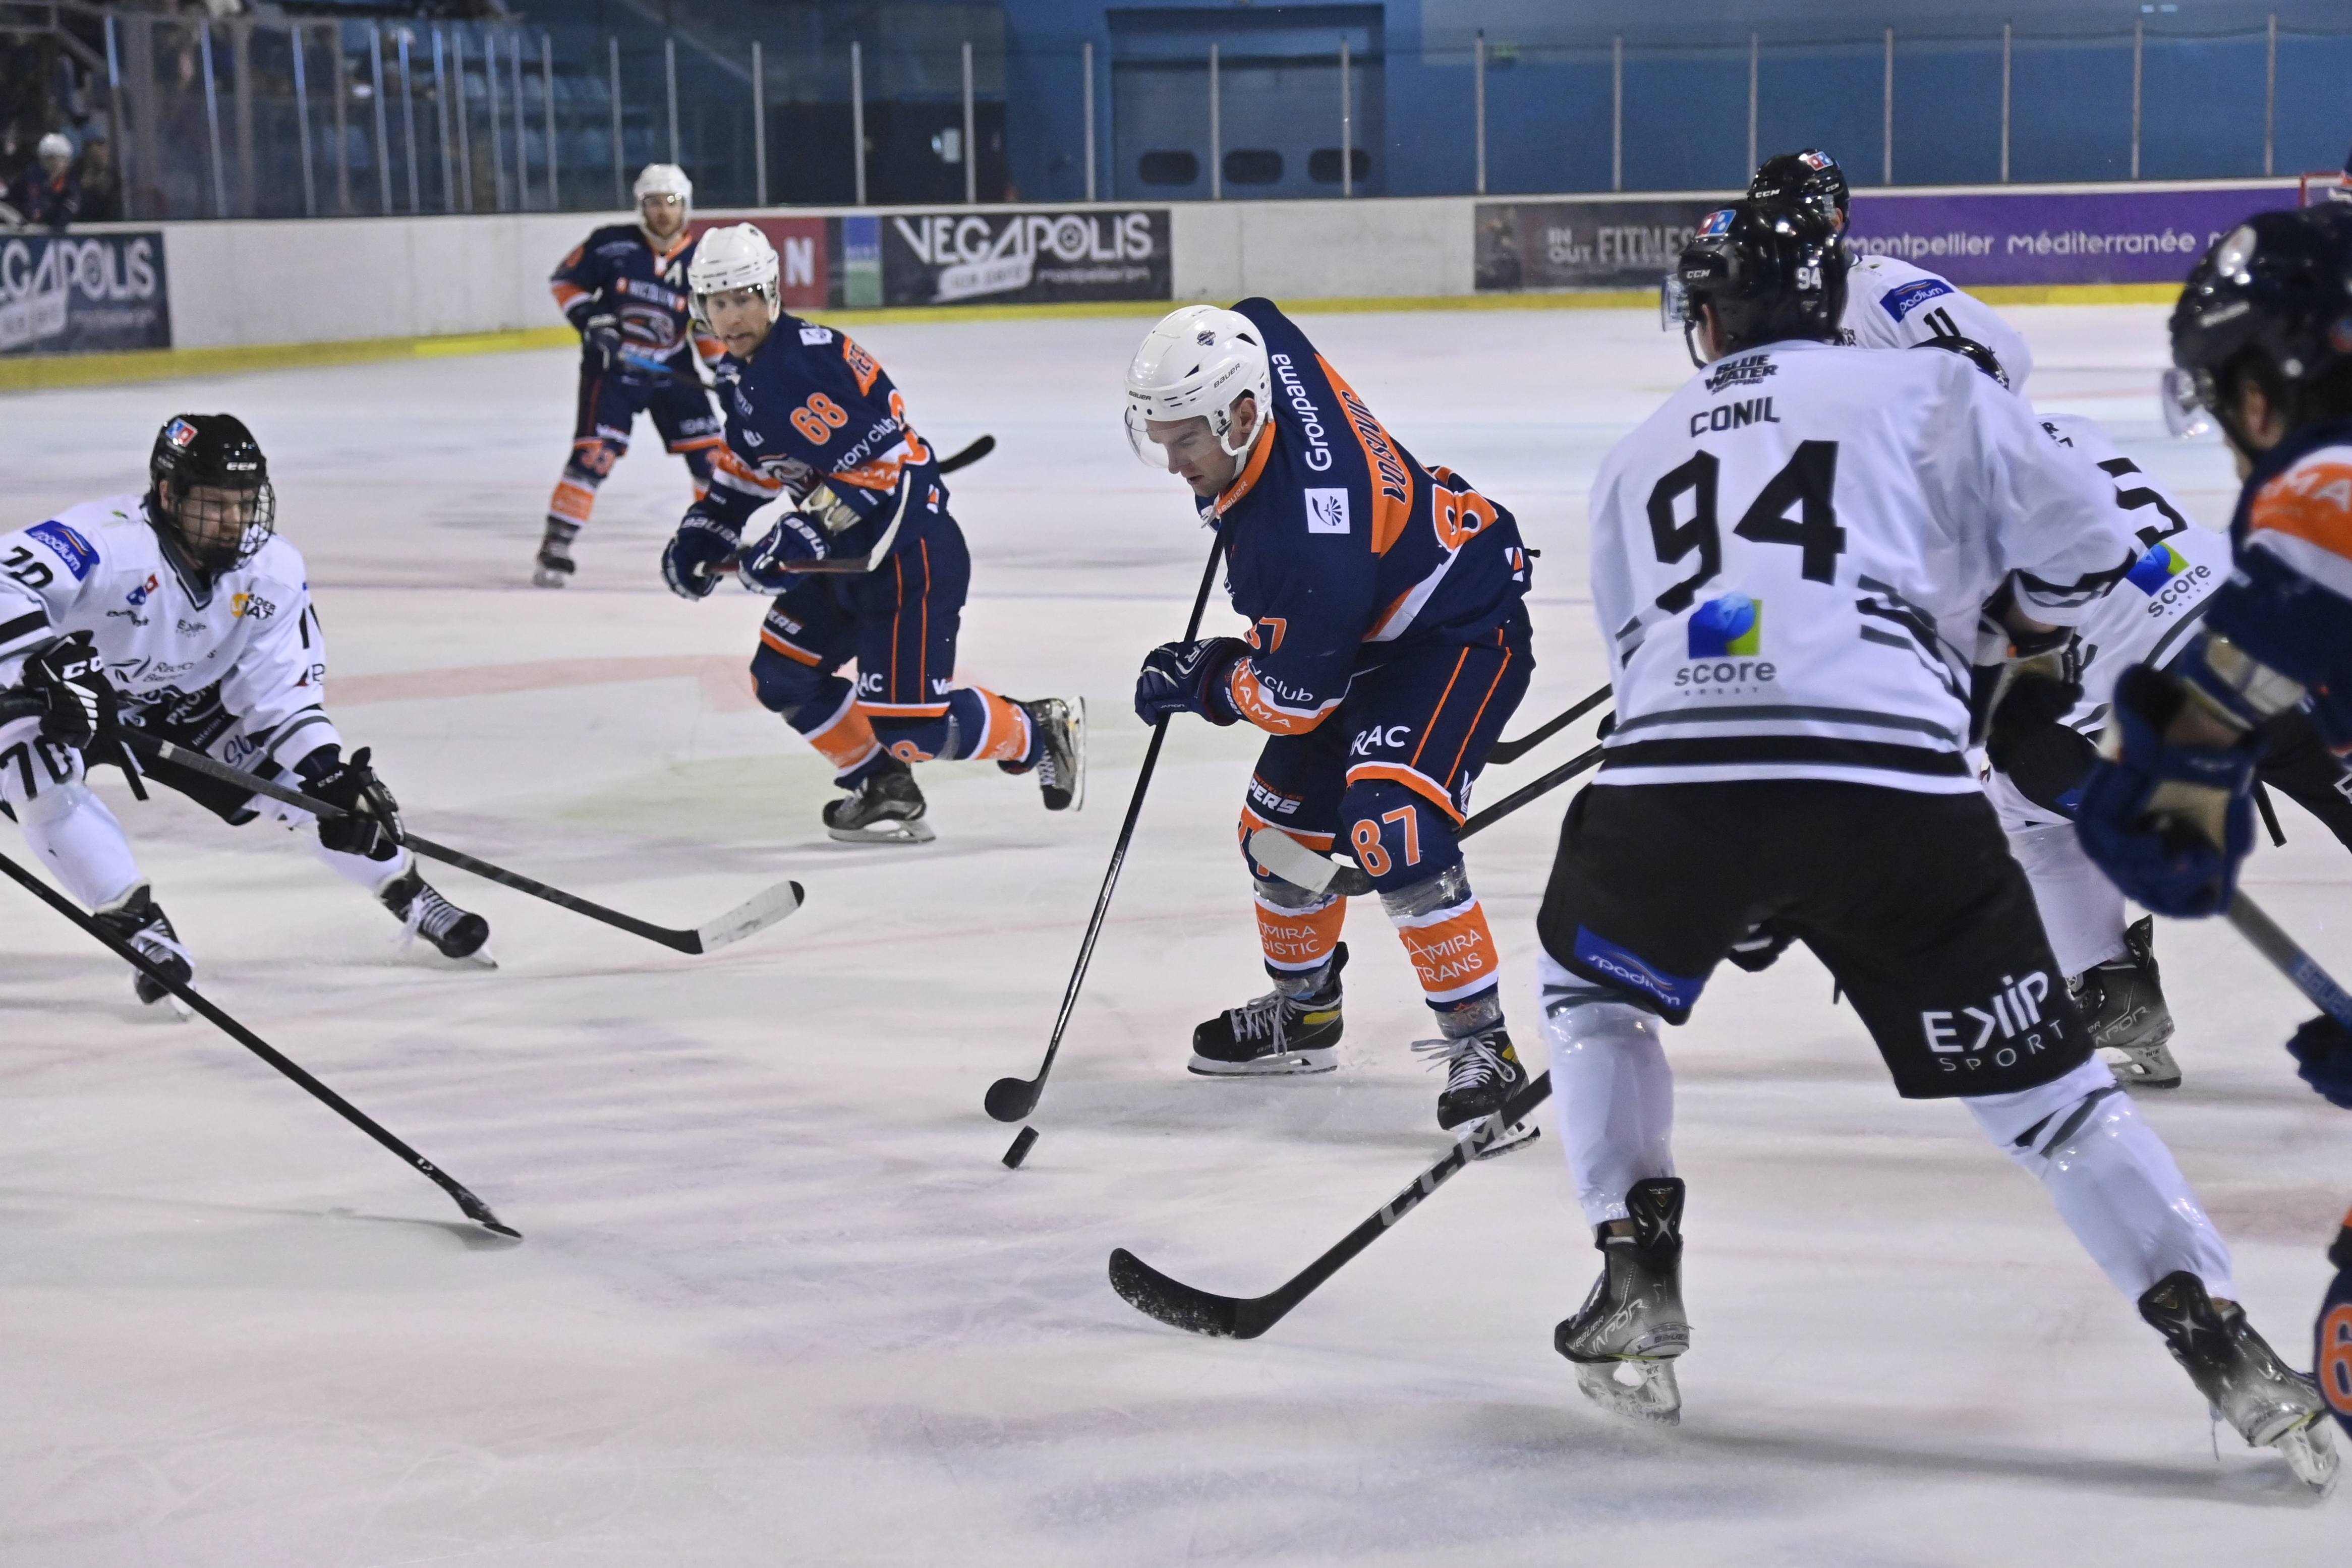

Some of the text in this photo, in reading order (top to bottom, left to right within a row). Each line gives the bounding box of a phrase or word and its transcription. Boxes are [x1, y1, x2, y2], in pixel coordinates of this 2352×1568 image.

[1755, 189, 1781, 199] CCM
[894, 213, 1154, 264] VEGAPOLIS
[1843, 231, 1994, 259] montpellier
[0, 238, 156, 302] GAPOLIS
[1686, 269, 1711, 279] CCM
[1795, 267, 1822, 290] 94
[1214, 363, 1241, 388] BAUER
[1705, 364, 1779, 390] WATER
[1128, 390, 1152, 401] BAUER
[789, 392, 849, 446] 68
[1271, 354, 1333, 472] Groupama
[1691, 396, 1781, 438] CONIL
[226, 461, 258, 471] CCM
[1221, 481, 1248, 512] BAUER
[1646, 439, 1847, 615] 94
[2148, 564, 2211, 618] score
[1265, 676, 1314, 702] club
[1674, 662, 1777, 687] score
[1350, 725, 1411, 756] RAC
[1351, 805, 1420, 877] 87
[1406, 929, 1483, 964] AMIRA
[1415, 952, 1483, 982] TRANS
[1589, 955, 1681, 1006] spadium
[1939, 1019, 2063, 1071] SPORT
[1381, 1110, 1506, 1227] CCM
[1575, 1315, 1604, 1348] BAUER
